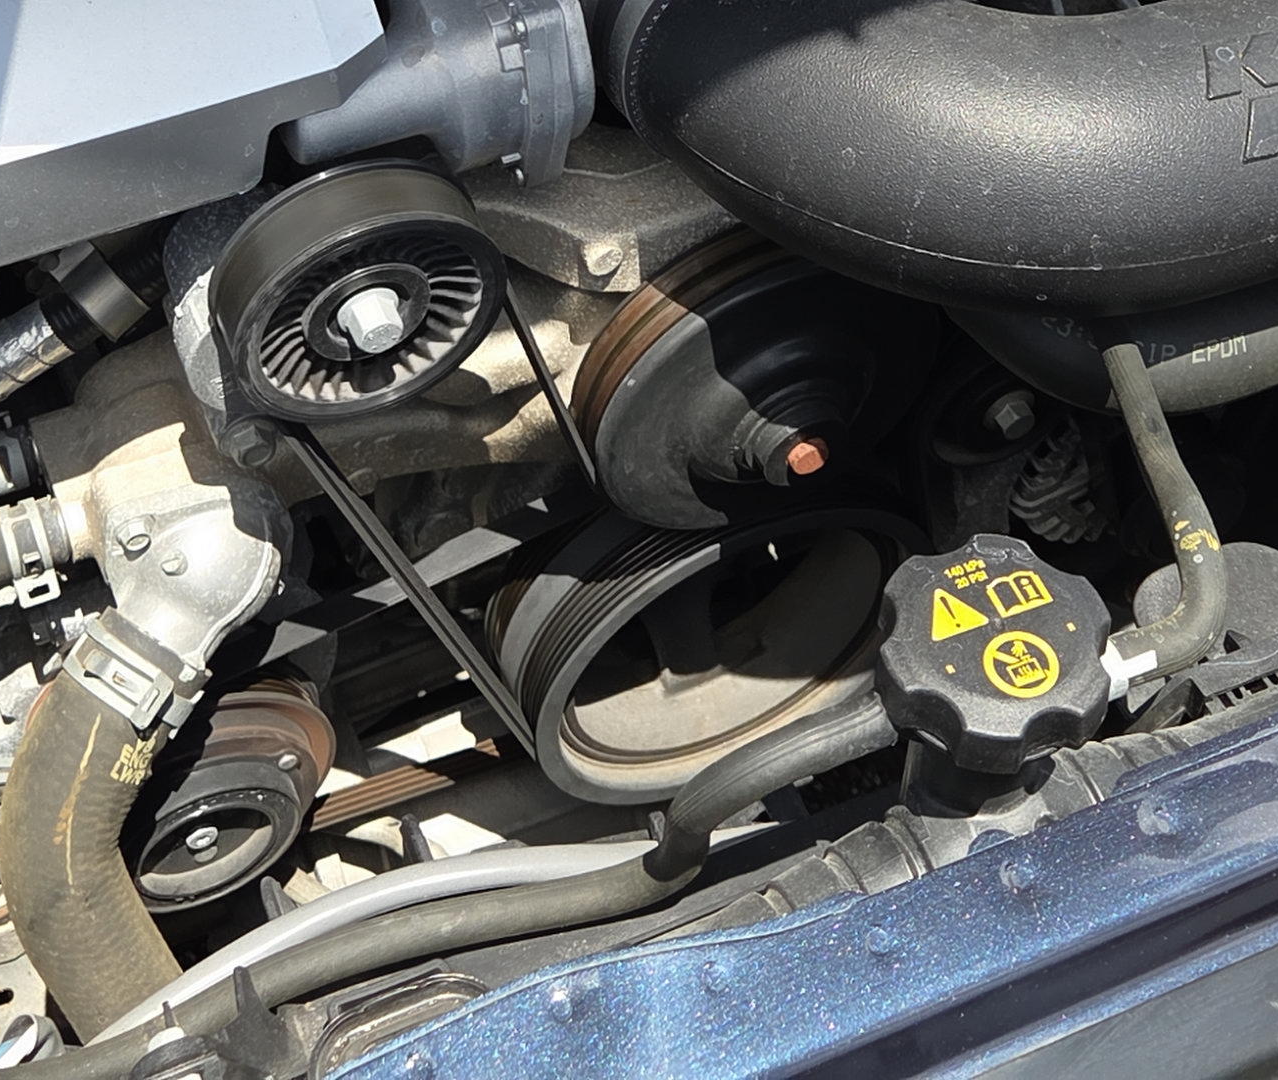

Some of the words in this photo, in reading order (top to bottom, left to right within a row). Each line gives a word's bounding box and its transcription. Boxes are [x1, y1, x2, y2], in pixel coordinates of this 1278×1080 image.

[1191, 332, 1247, 365] EPDM
[963, 559, 986, 573] kPa
[954, 577, 969, 590] 20
[967, 570, 988, 584] PSI
[119, 742, 153, 768] ENG
[109, 759, 146, 786] LWR
